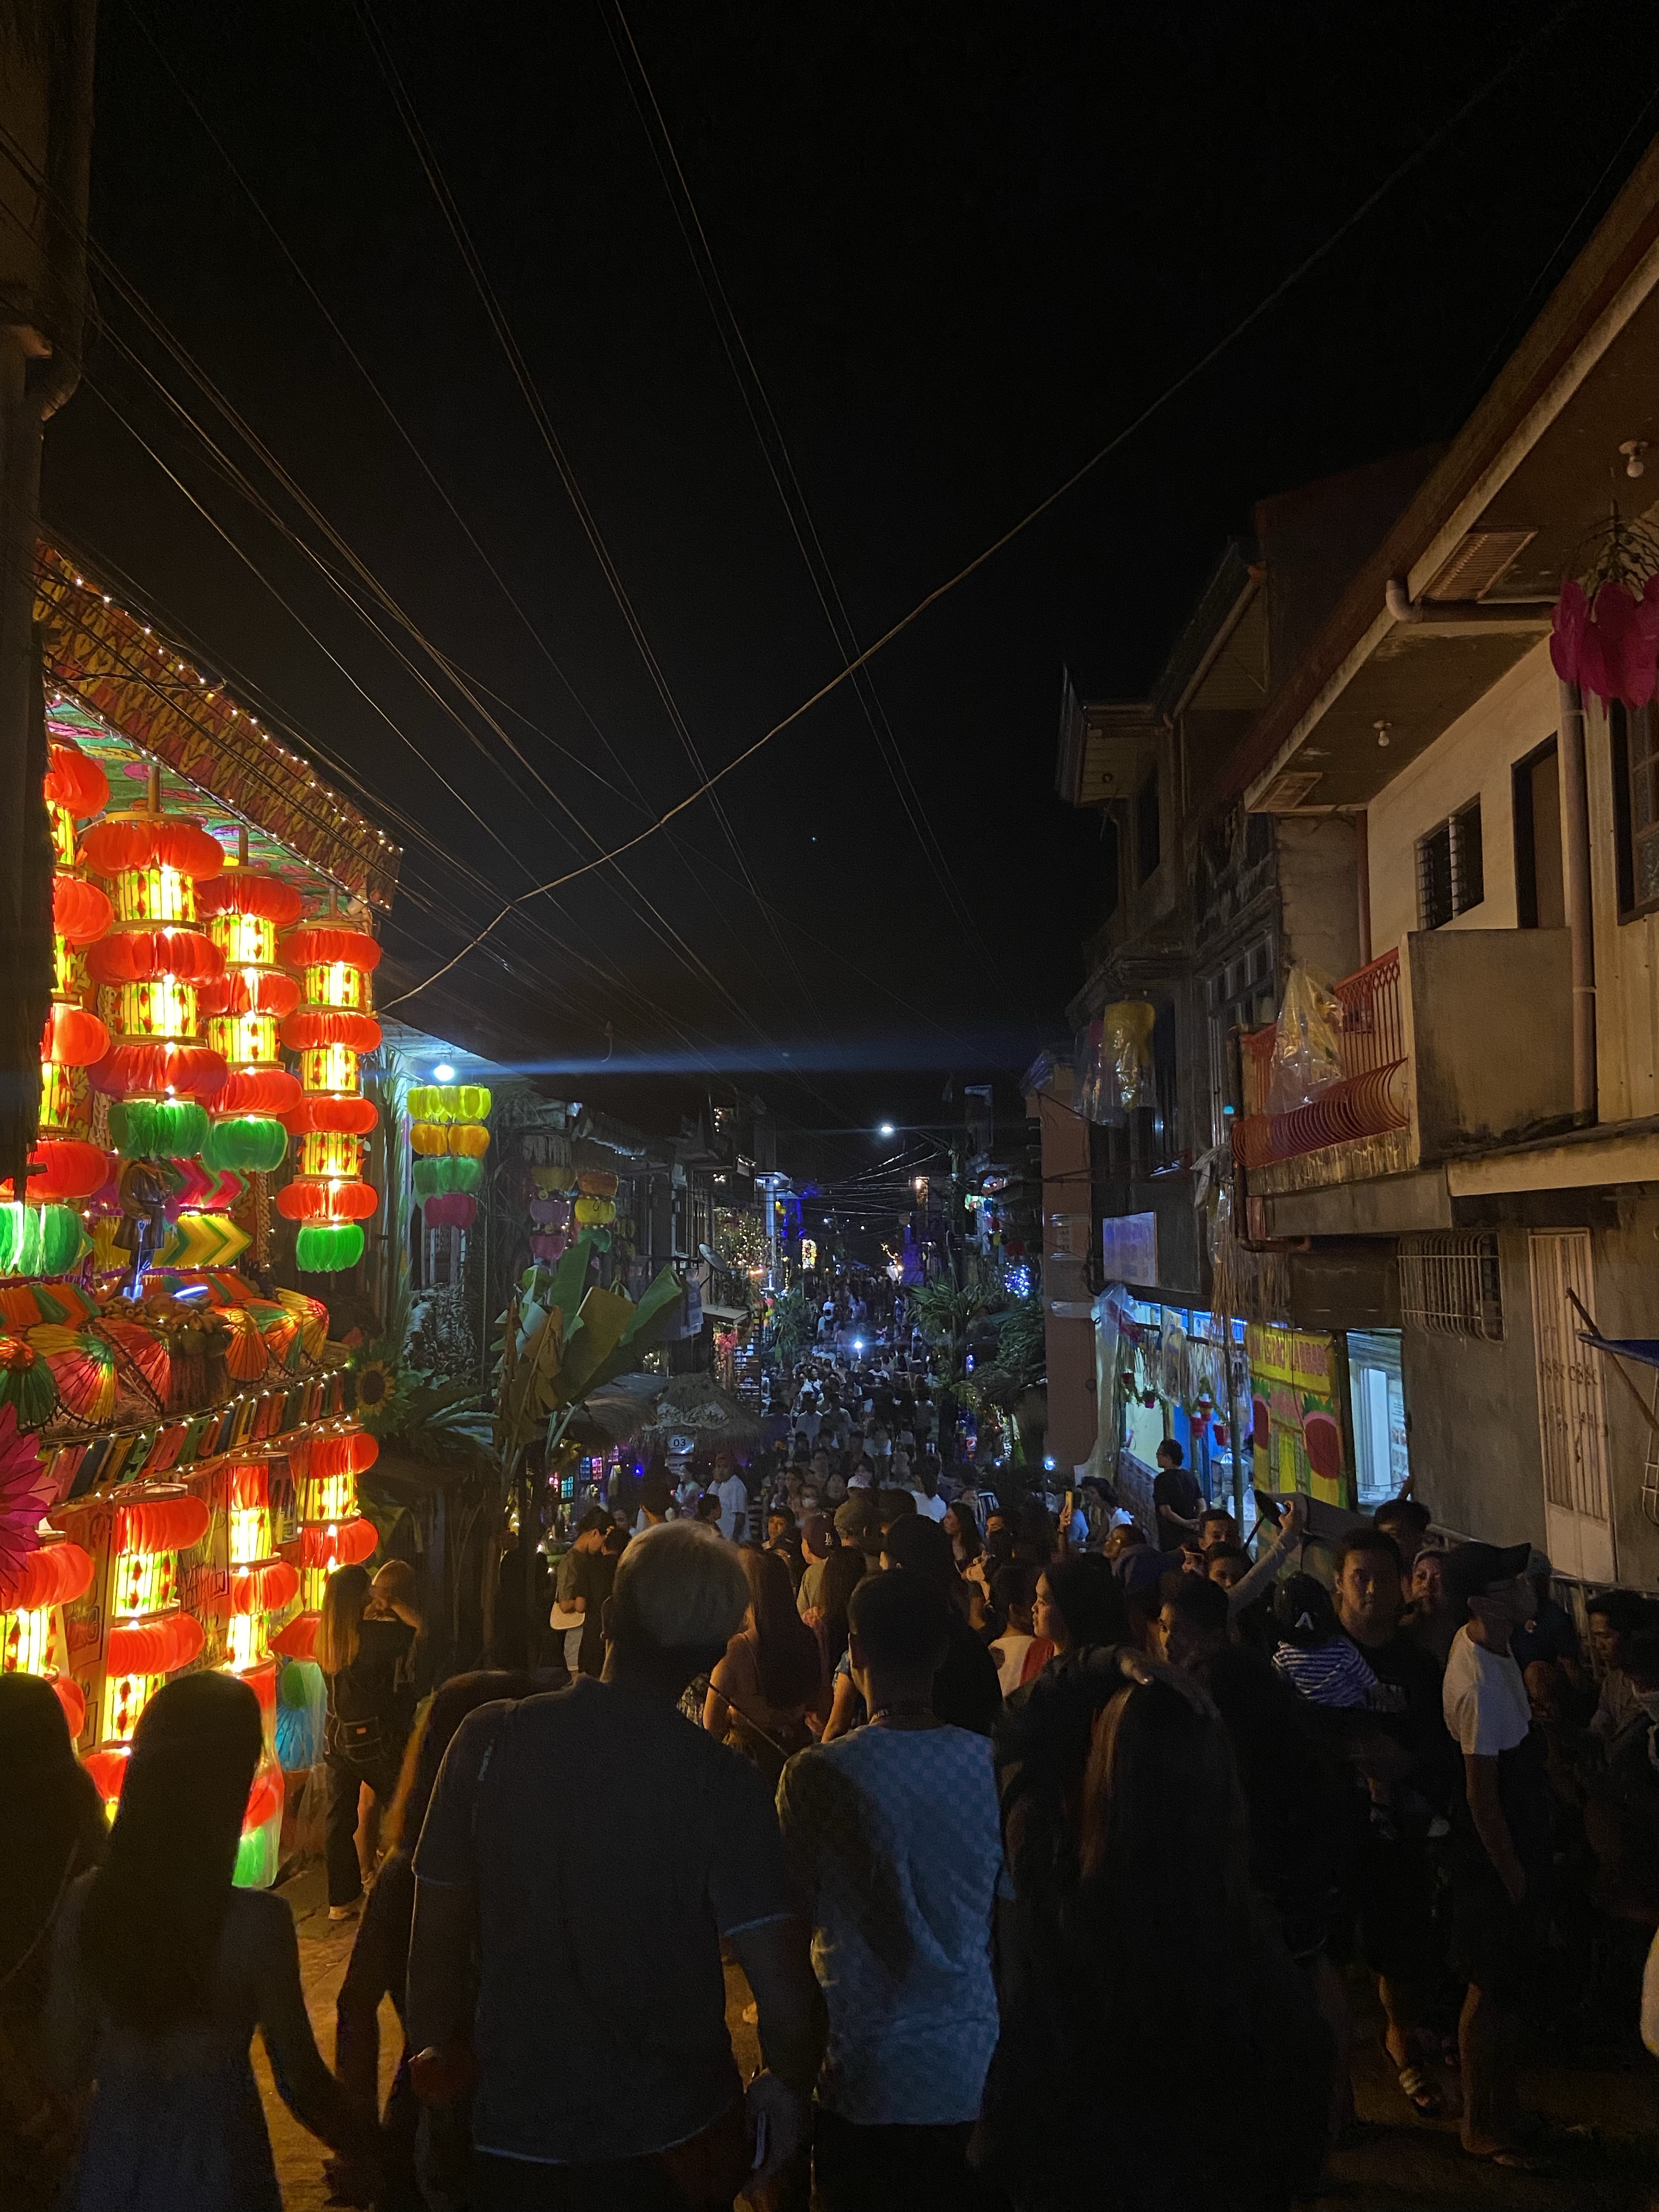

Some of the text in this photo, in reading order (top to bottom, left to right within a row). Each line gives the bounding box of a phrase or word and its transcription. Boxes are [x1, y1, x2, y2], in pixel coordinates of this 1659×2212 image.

[674, 1438, 686, 1447] 03
[825, 1532, 833, 1545] LA
[1295, 1611, 1314, 1630] A
